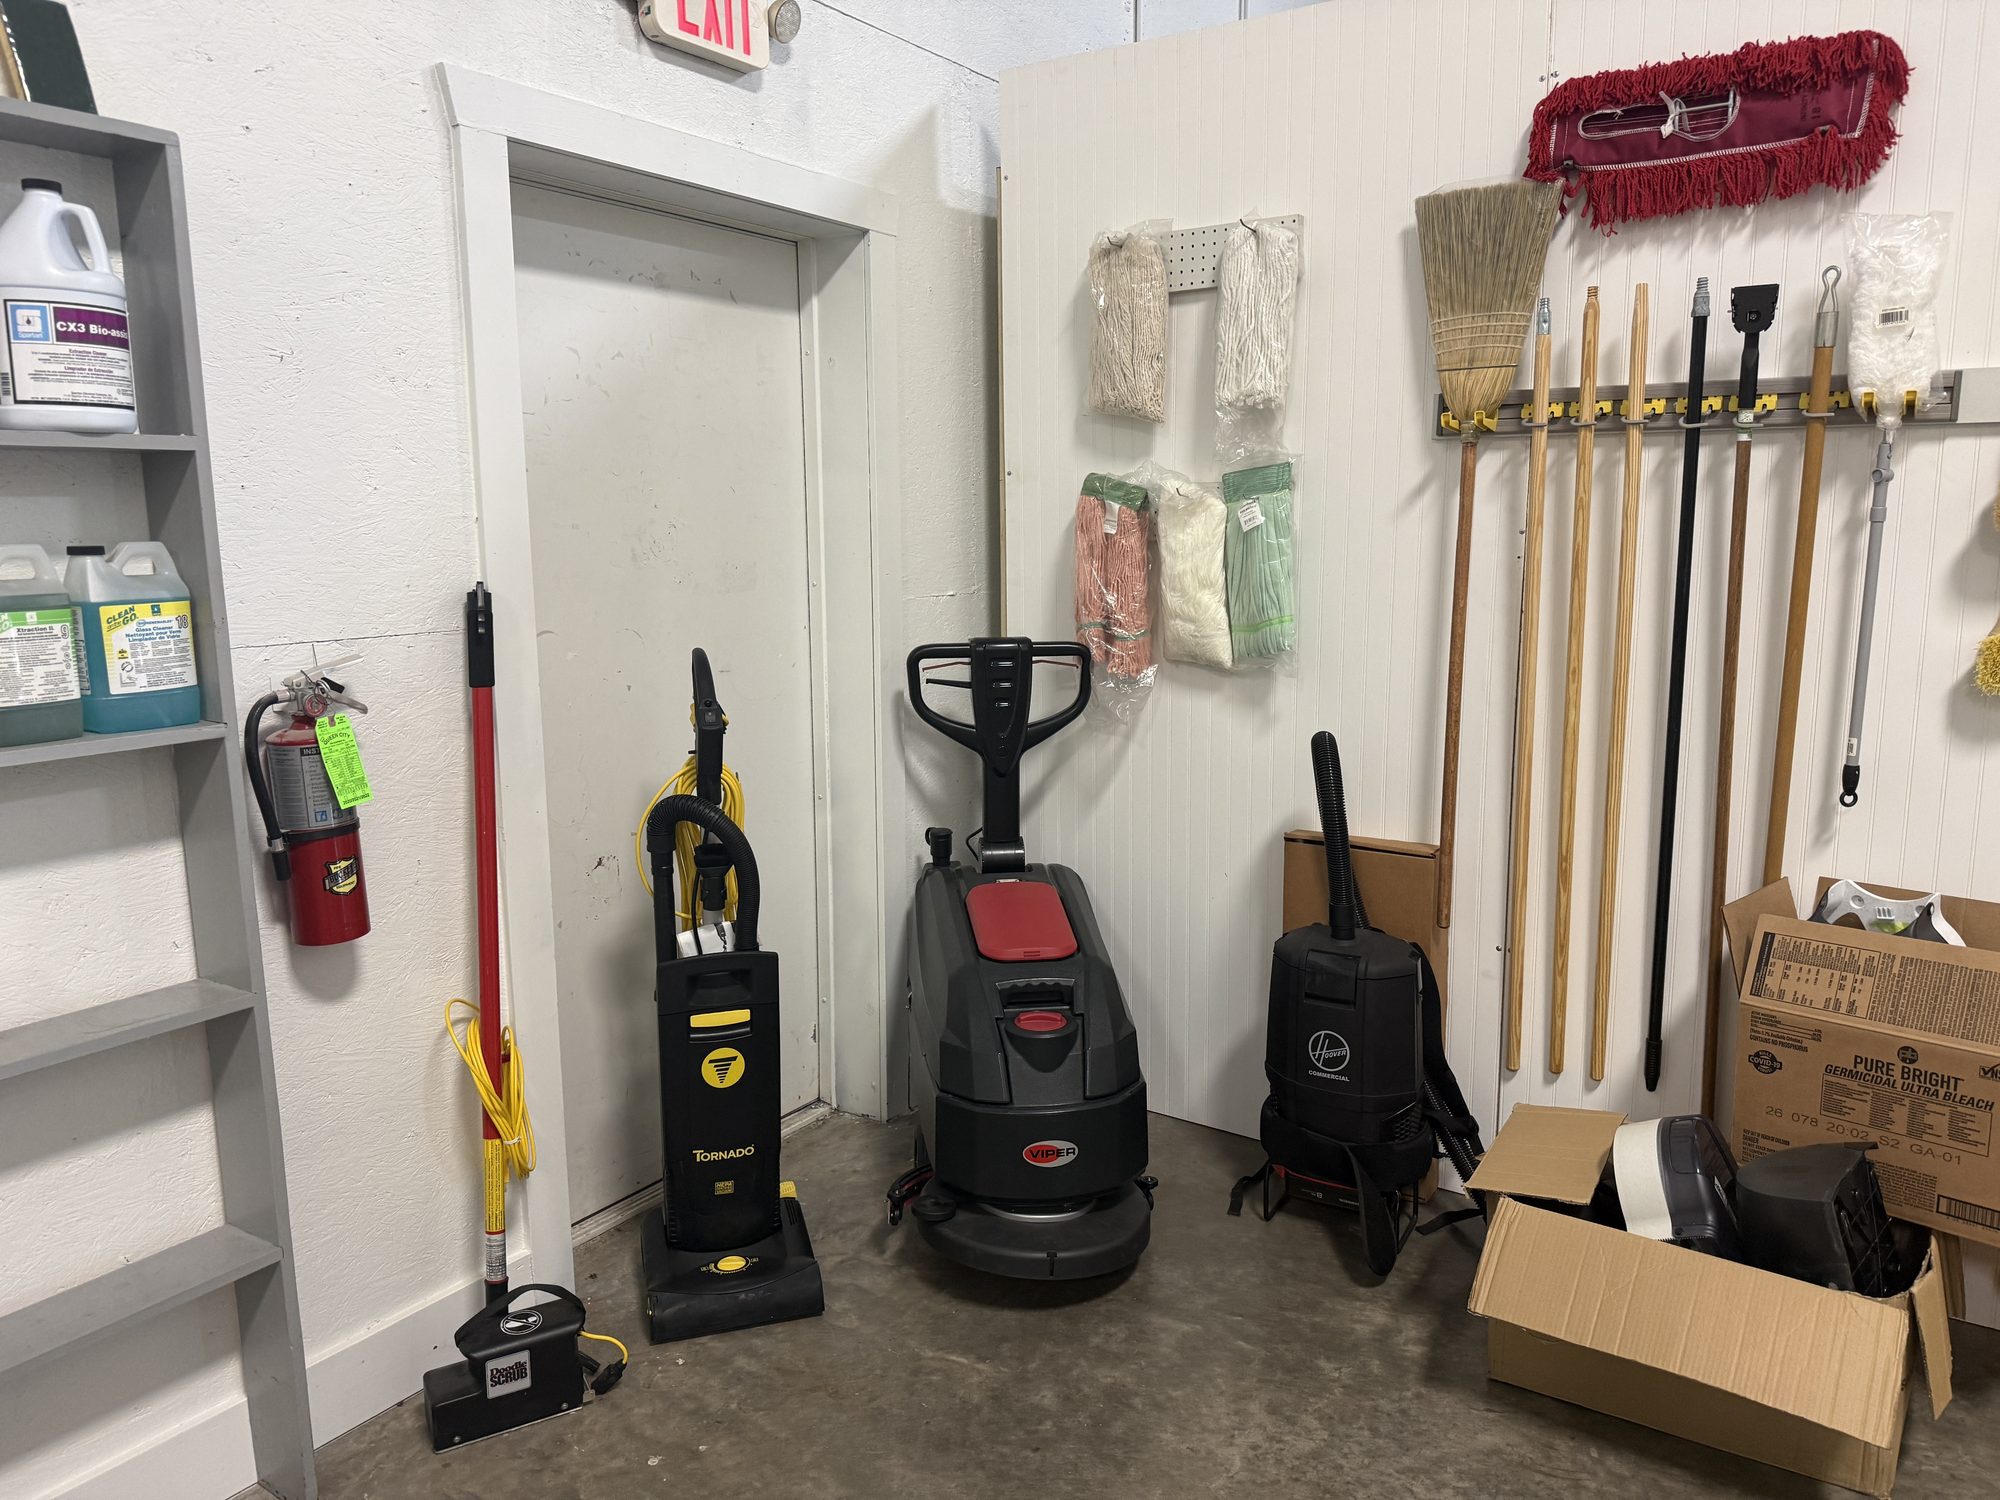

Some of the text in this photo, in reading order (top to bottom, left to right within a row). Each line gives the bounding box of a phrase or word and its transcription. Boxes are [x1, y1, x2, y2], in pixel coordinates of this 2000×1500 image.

[56, 321, 86, 333] CX3
[106, 605, 135, 625] CLEAN
[175, 614, 188, 629] 18
[61, 624, 69, 639] 9
[1308, 1069, 1350, 1082] COMMERCIAL
[1853, 1054, 1962, 1092] PURE BRIGHT
[1824, 1064, 1995, 1111] GERMICIDAL ULTRA BLEACH
[1766, 1105, 1961, 1166] 26 078 20:02 S2 GA-01
[692, 1146, 755, 1162] TORNADO
[1029, 1147, 1076, 1159] VIPER
[490, 1367, 528, 1388] SCRUB
